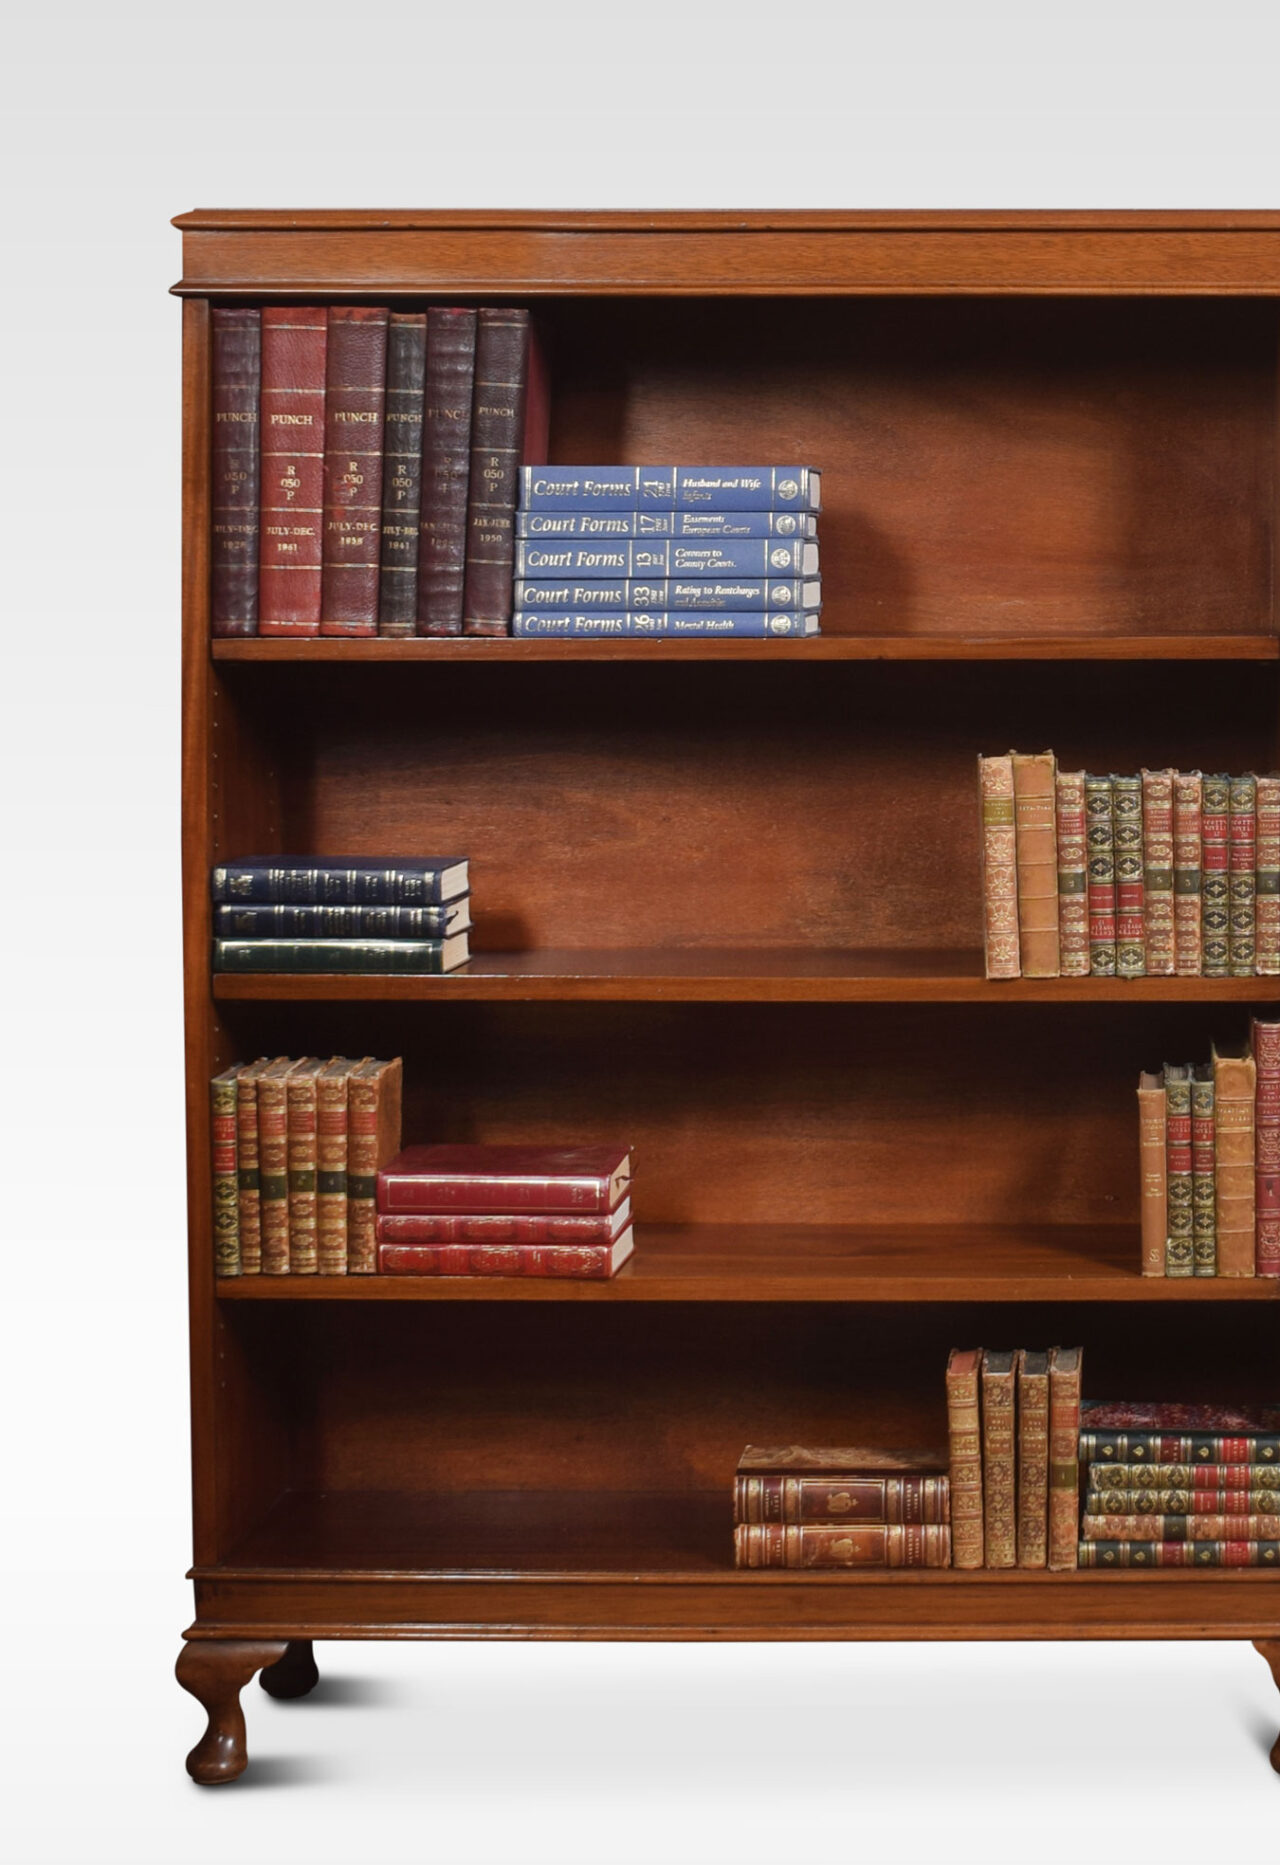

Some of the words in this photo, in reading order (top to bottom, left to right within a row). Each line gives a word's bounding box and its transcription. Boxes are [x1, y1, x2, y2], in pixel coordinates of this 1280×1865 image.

[216, 412, 257, 423] PUNCH
[334, 412, 378, 423] PUNCH
[478, 406, 515, 418] PUNCH
[271, 414, 313, 425] PUNCH
[386, 413, 422, 423] PUNCH
[349, 461, 358, 472] R
[490, 456, 500, 467] R
[287, 465, 296, 476] R
[397, 465, 407, 475] R
[483, 469, 504, 480] 050
[280, 479, 301, 489] 050
[392, 478, 412, 488] 050
[489, 482, 499, 492] P
[534, 480, 579, 496] Court
[583, 480, 631, 496] Forms
[682, 478, 721, 488] Husband
[722, 478, 739, 488] and
[740, 478, 762, 491] Wife
[286, 491, 295, 501] P
[350, 487, 358, 497] P
[397, 490, 407, 500] P
[530, 516, 576, 532] Court
[580, 517, 629, 533] Forms
[640, 514, 656, 533] 17
[712, 549, 723, 557] to
[528, 551, 572, 567] Court
[576, 551, 625, 567] Forms
[636, 552, 652, 567] 13
[524, 587, 569, 604] Court
[573, 588, 622, 604] Forms
[633, 586, 650, 606] 33
[675, 585, 702, 597] Rating
[703, 586, 713, 595] to
[525, 616, 570, 632] Court
[575, 616, 623, 632] Forms
